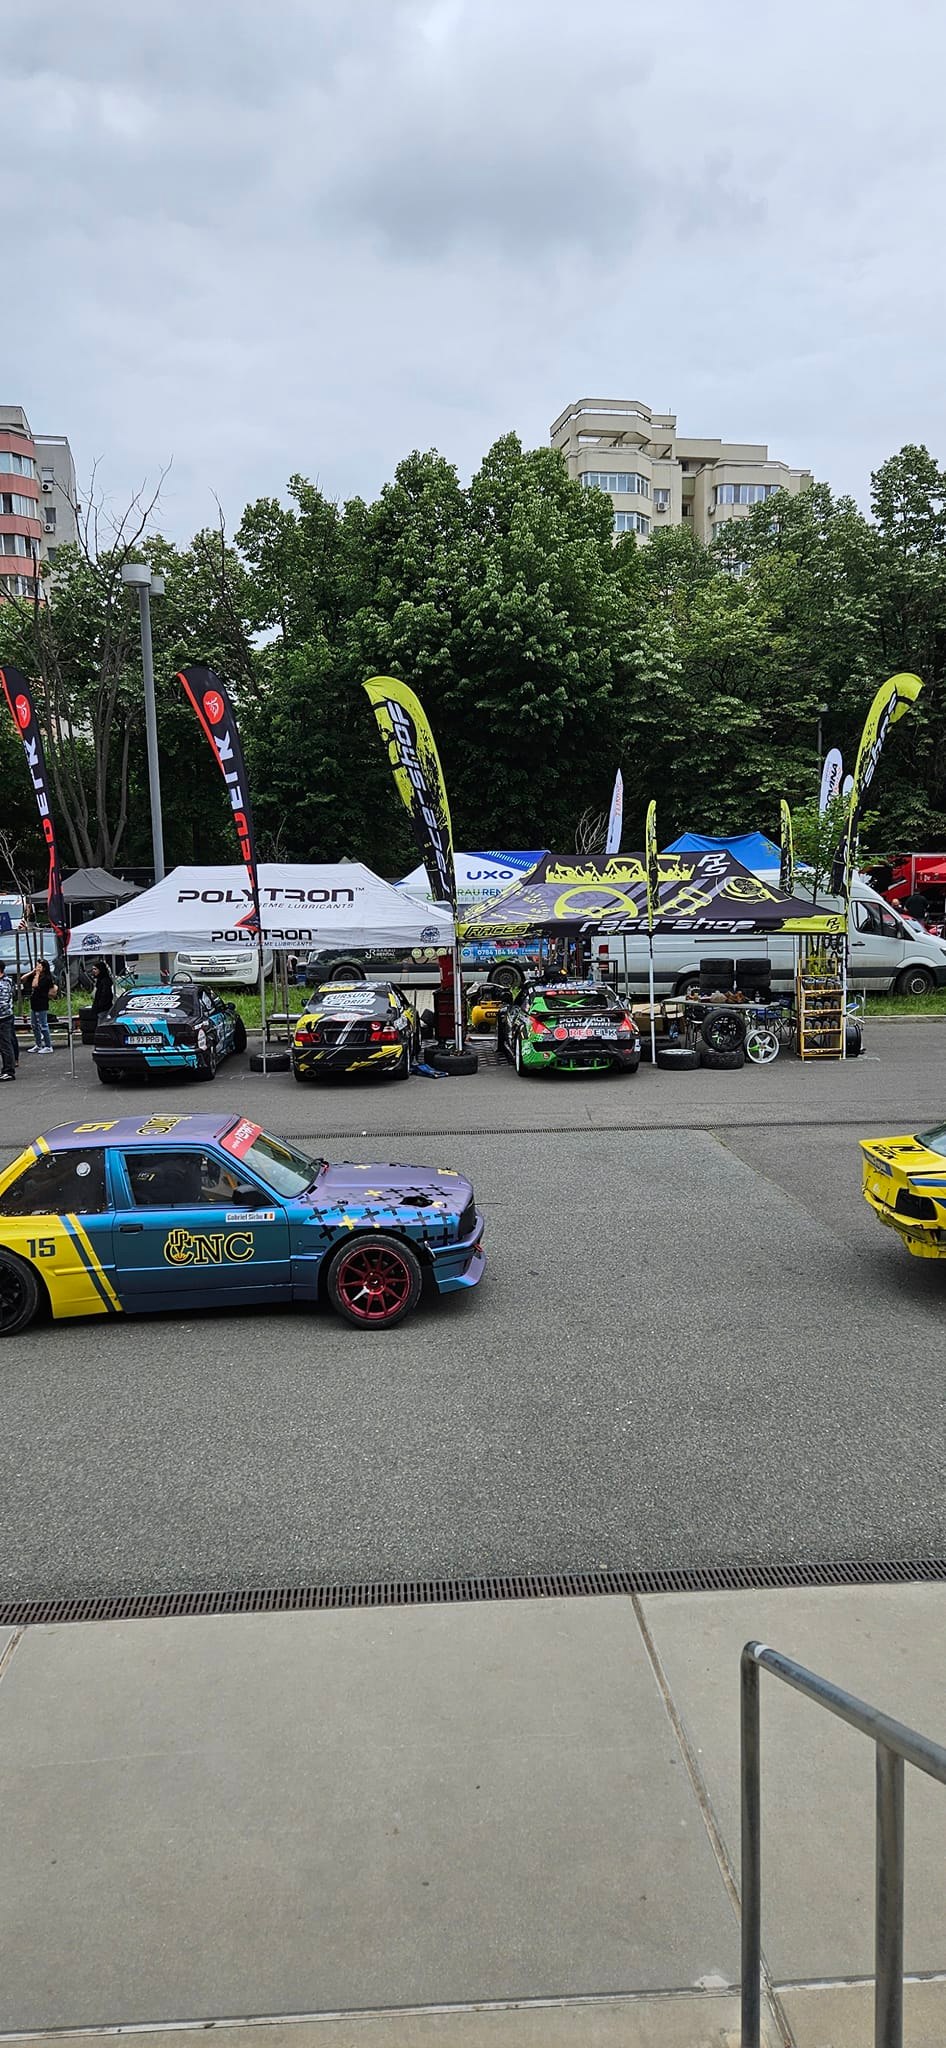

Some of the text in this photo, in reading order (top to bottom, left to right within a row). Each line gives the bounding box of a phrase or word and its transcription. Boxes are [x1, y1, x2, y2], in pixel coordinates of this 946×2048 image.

[467, 870, 514, 881] UXO
[177, 887, 355, 903] POLYTRON
[457, 887, 480, 897] RAU
[579, 917, 756, 934] race-shop
[211, 928, 313, 943] POLYTRON
[569, 1028, 617, 1038] REDELK
[26, 1238, 56, 1258] 15
[164, 1229, 255, 1266] CNC
